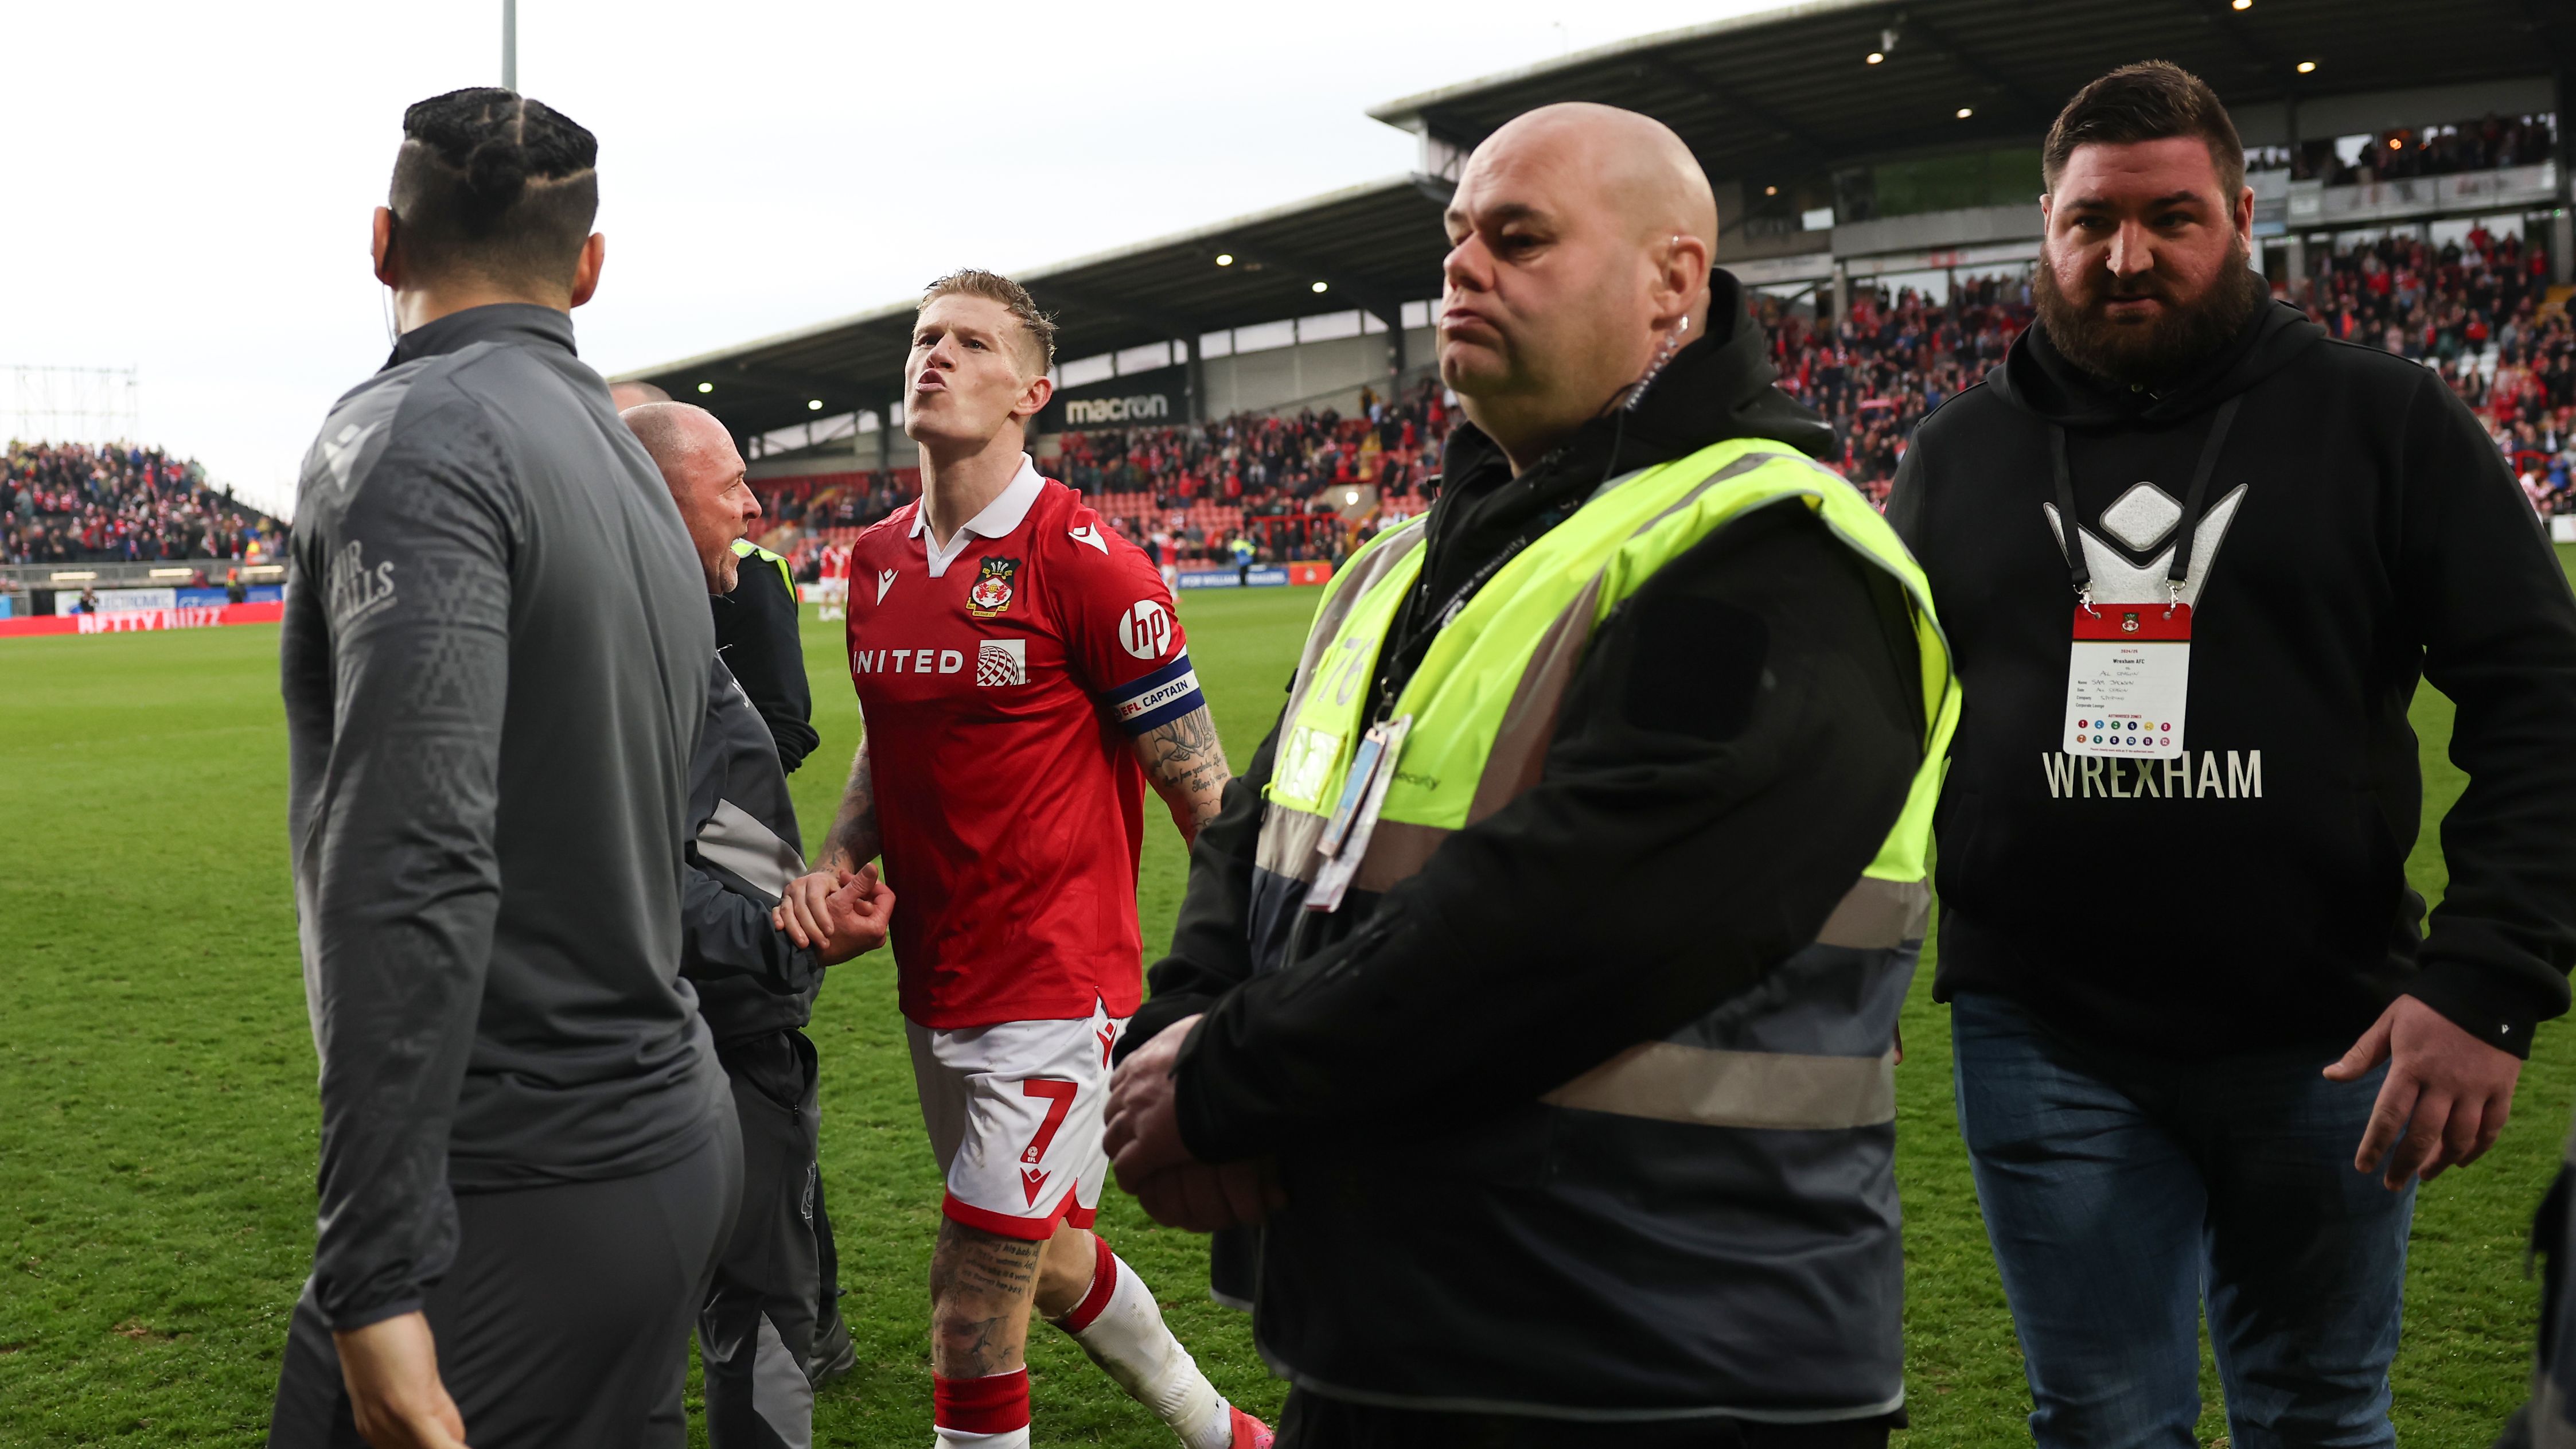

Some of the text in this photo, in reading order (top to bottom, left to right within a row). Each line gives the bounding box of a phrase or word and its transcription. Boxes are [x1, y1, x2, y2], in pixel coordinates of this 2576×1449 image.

[1066, 394, 1168, 424] macron
[1129, 603, 1164, 659] hp
[1318, 637, 1375, 706] 76
[1120, 680, 1188, 716] EFL CAPTAIN
[2042, 750, 2262, 798] WREXHAM
[1020, 1078, 1078, 1164] 7
